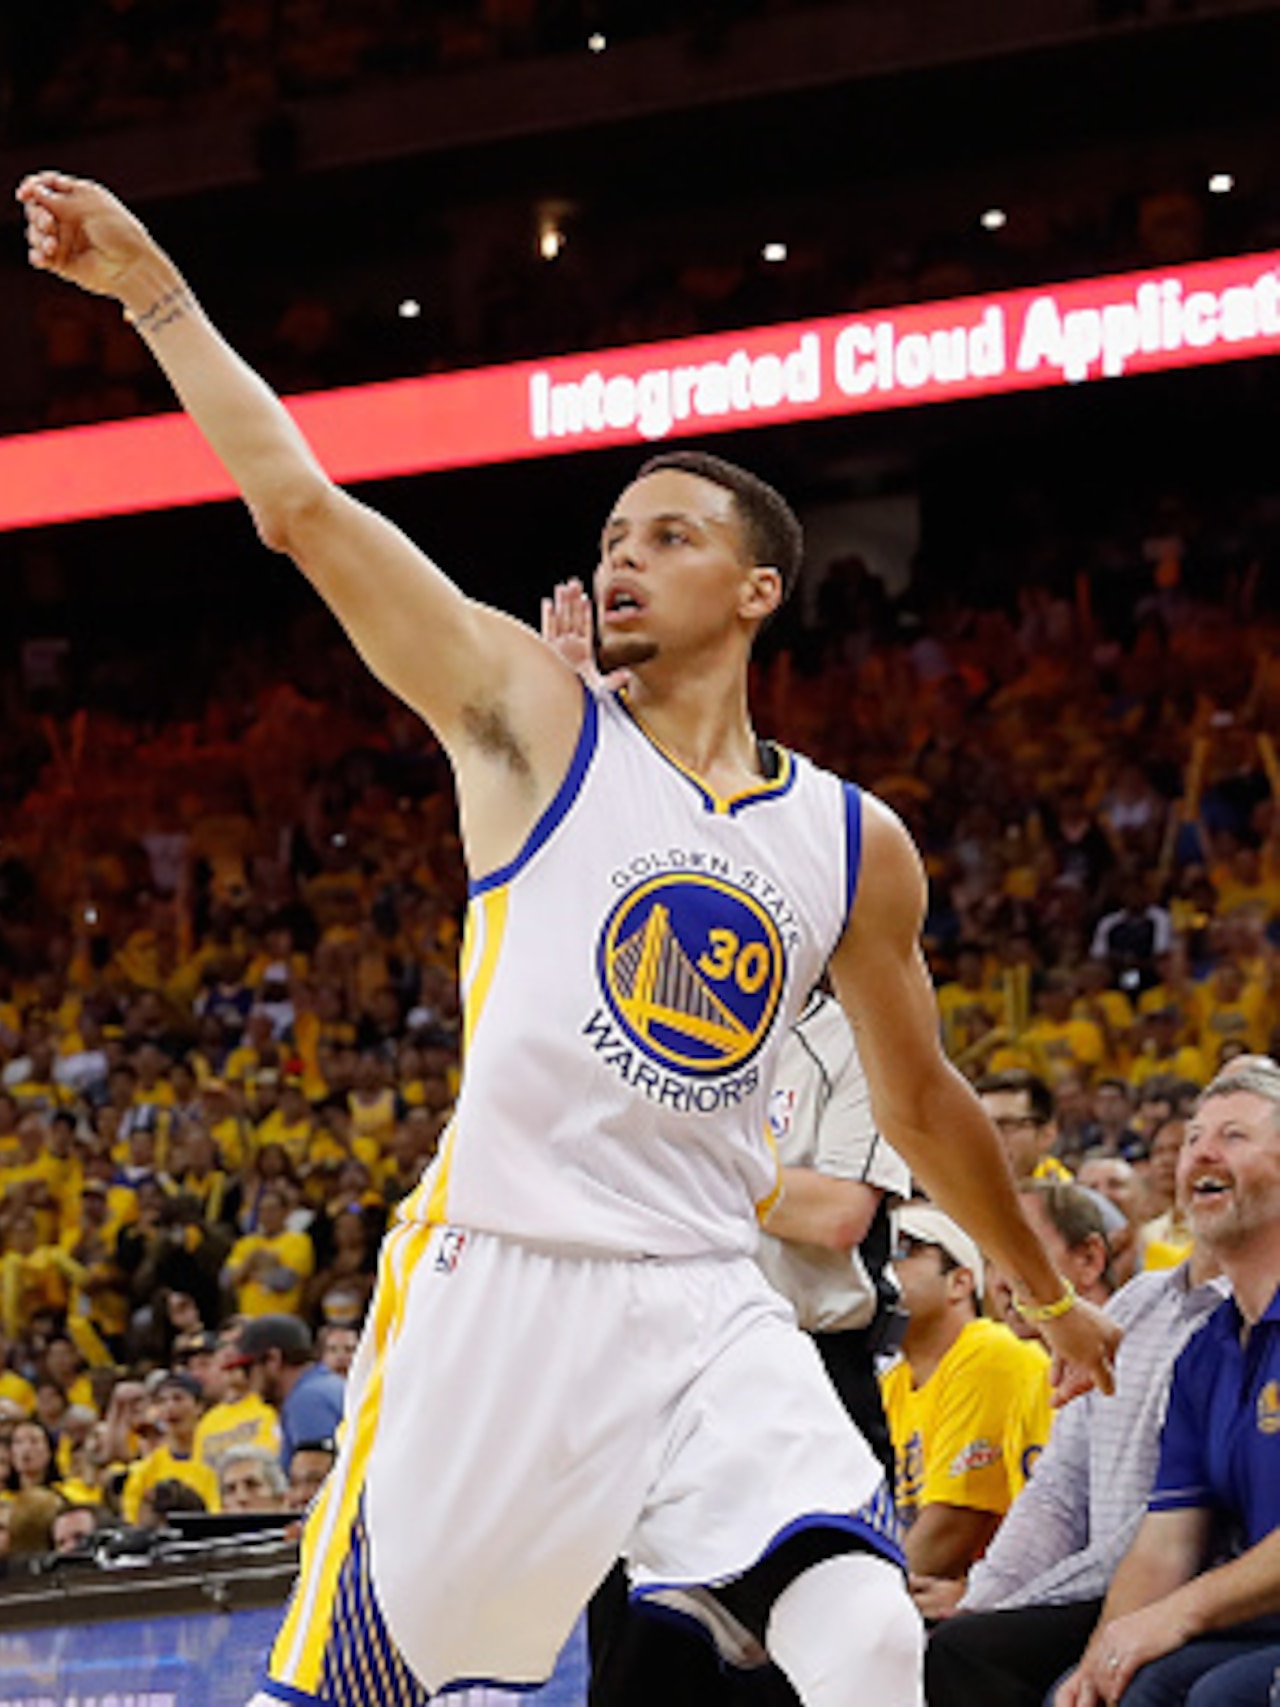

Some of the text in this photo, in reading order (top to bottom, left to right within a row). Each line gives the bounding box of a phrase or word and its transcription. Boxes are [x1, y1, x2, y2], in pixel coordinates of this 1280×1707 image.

[529, 332, 821, 439] Integrated
[834, 308, 1004, 394] Cloud
[610, 848, 730, 889] GOLDEN
[696, 927, 770, 994] 30
[581, 1009, 760, 1113] WARRIORS
